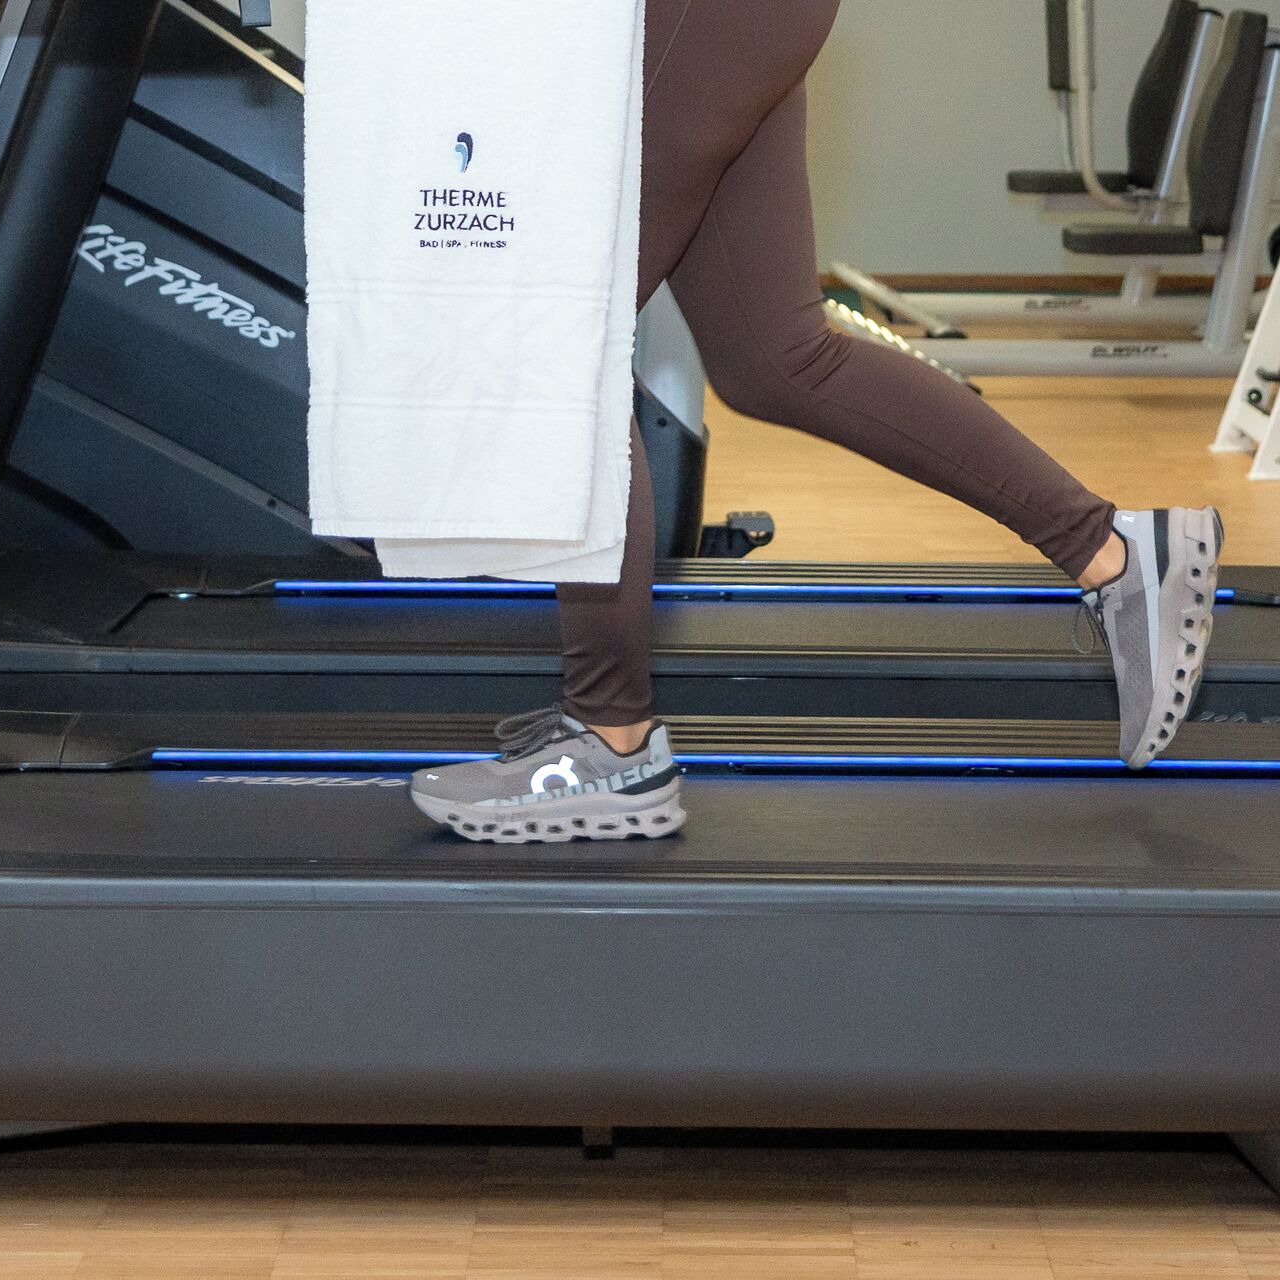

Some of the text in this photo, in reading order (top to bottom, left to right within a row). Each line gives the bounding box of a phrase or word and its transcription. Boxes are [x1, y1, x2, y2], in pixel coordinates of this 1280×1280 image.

[419, 189, 508, 208] THERME
[413, 213, 515, 232] ZURZACH
[419, 240, 439, 248] BAD
[445, 239, 462, 249] SPA
